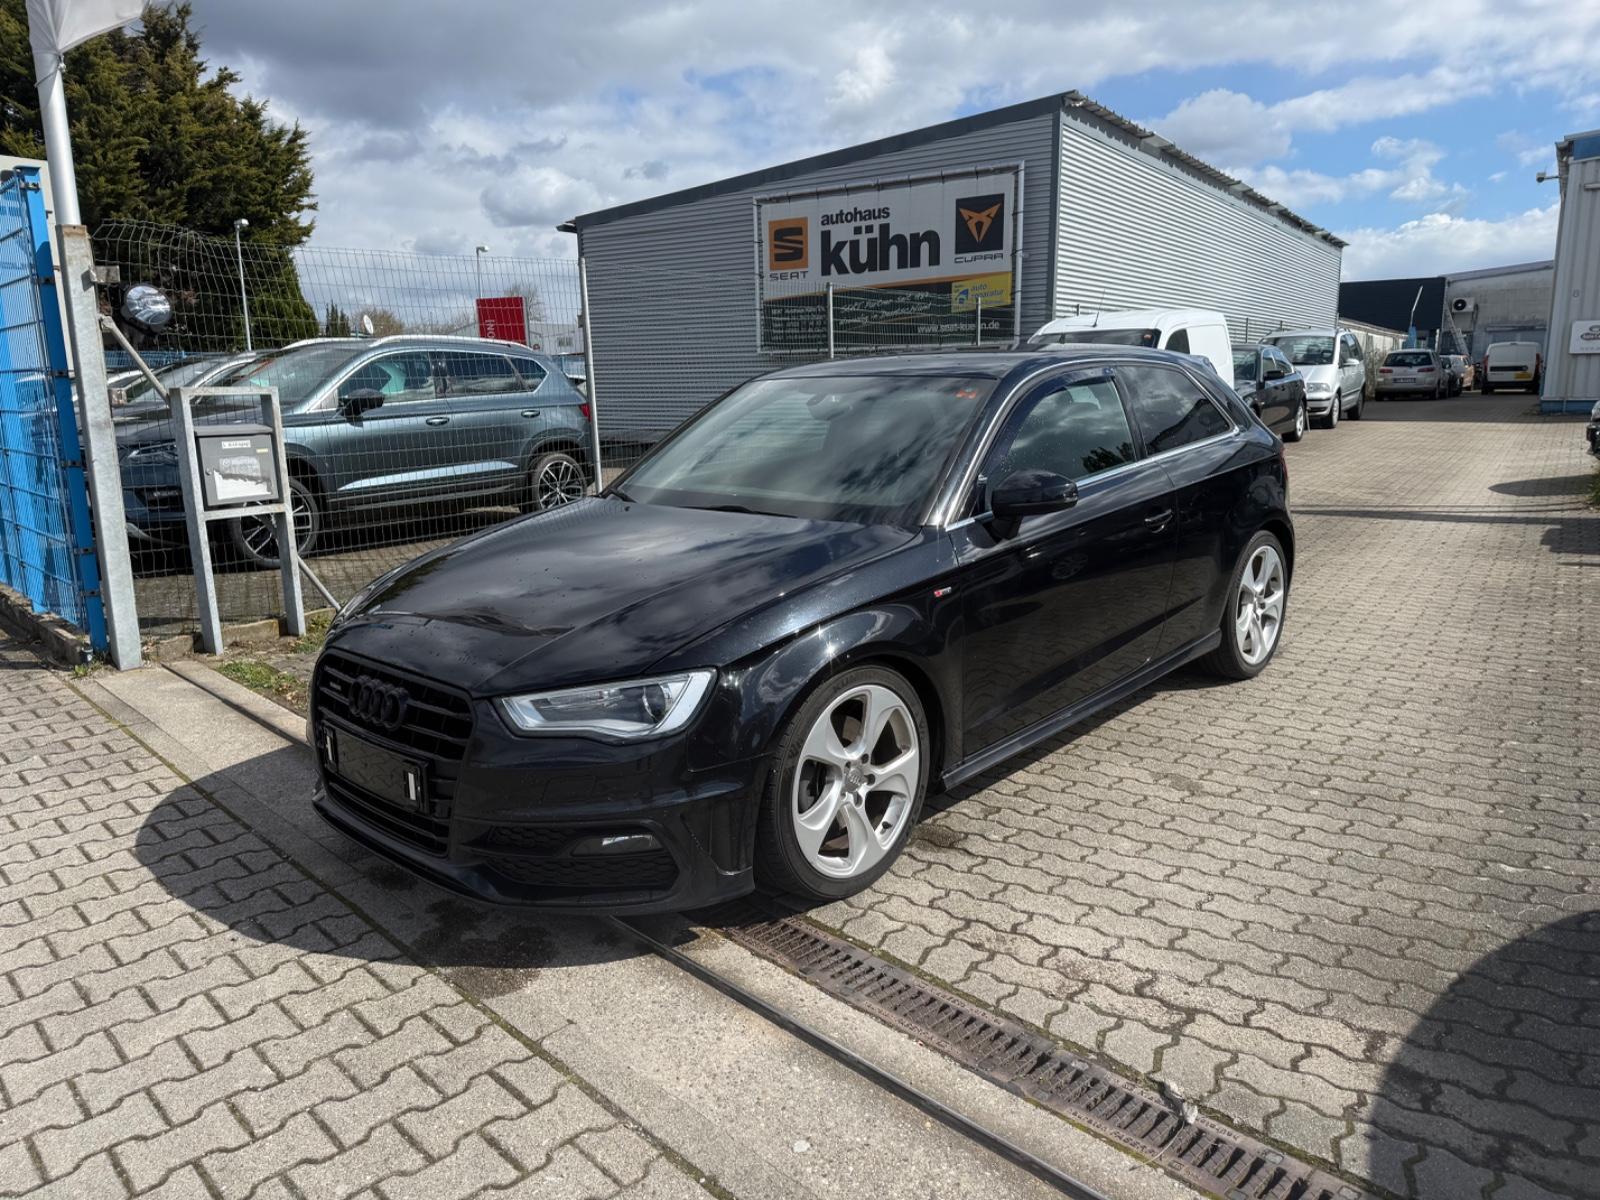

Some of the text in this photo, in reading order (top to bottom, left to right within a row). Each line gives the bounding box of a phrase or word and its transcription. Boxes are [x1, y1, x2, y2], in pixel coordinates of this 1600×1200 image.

[820, 206, 890, 226] autohaus
[820, 222, 941, 277] kühn
[953, 252, 1004, 264] CUPRA
[769, 270, 809, 281] SEAT
[917, 320, 1000, 333] www.seat-kuen.de
